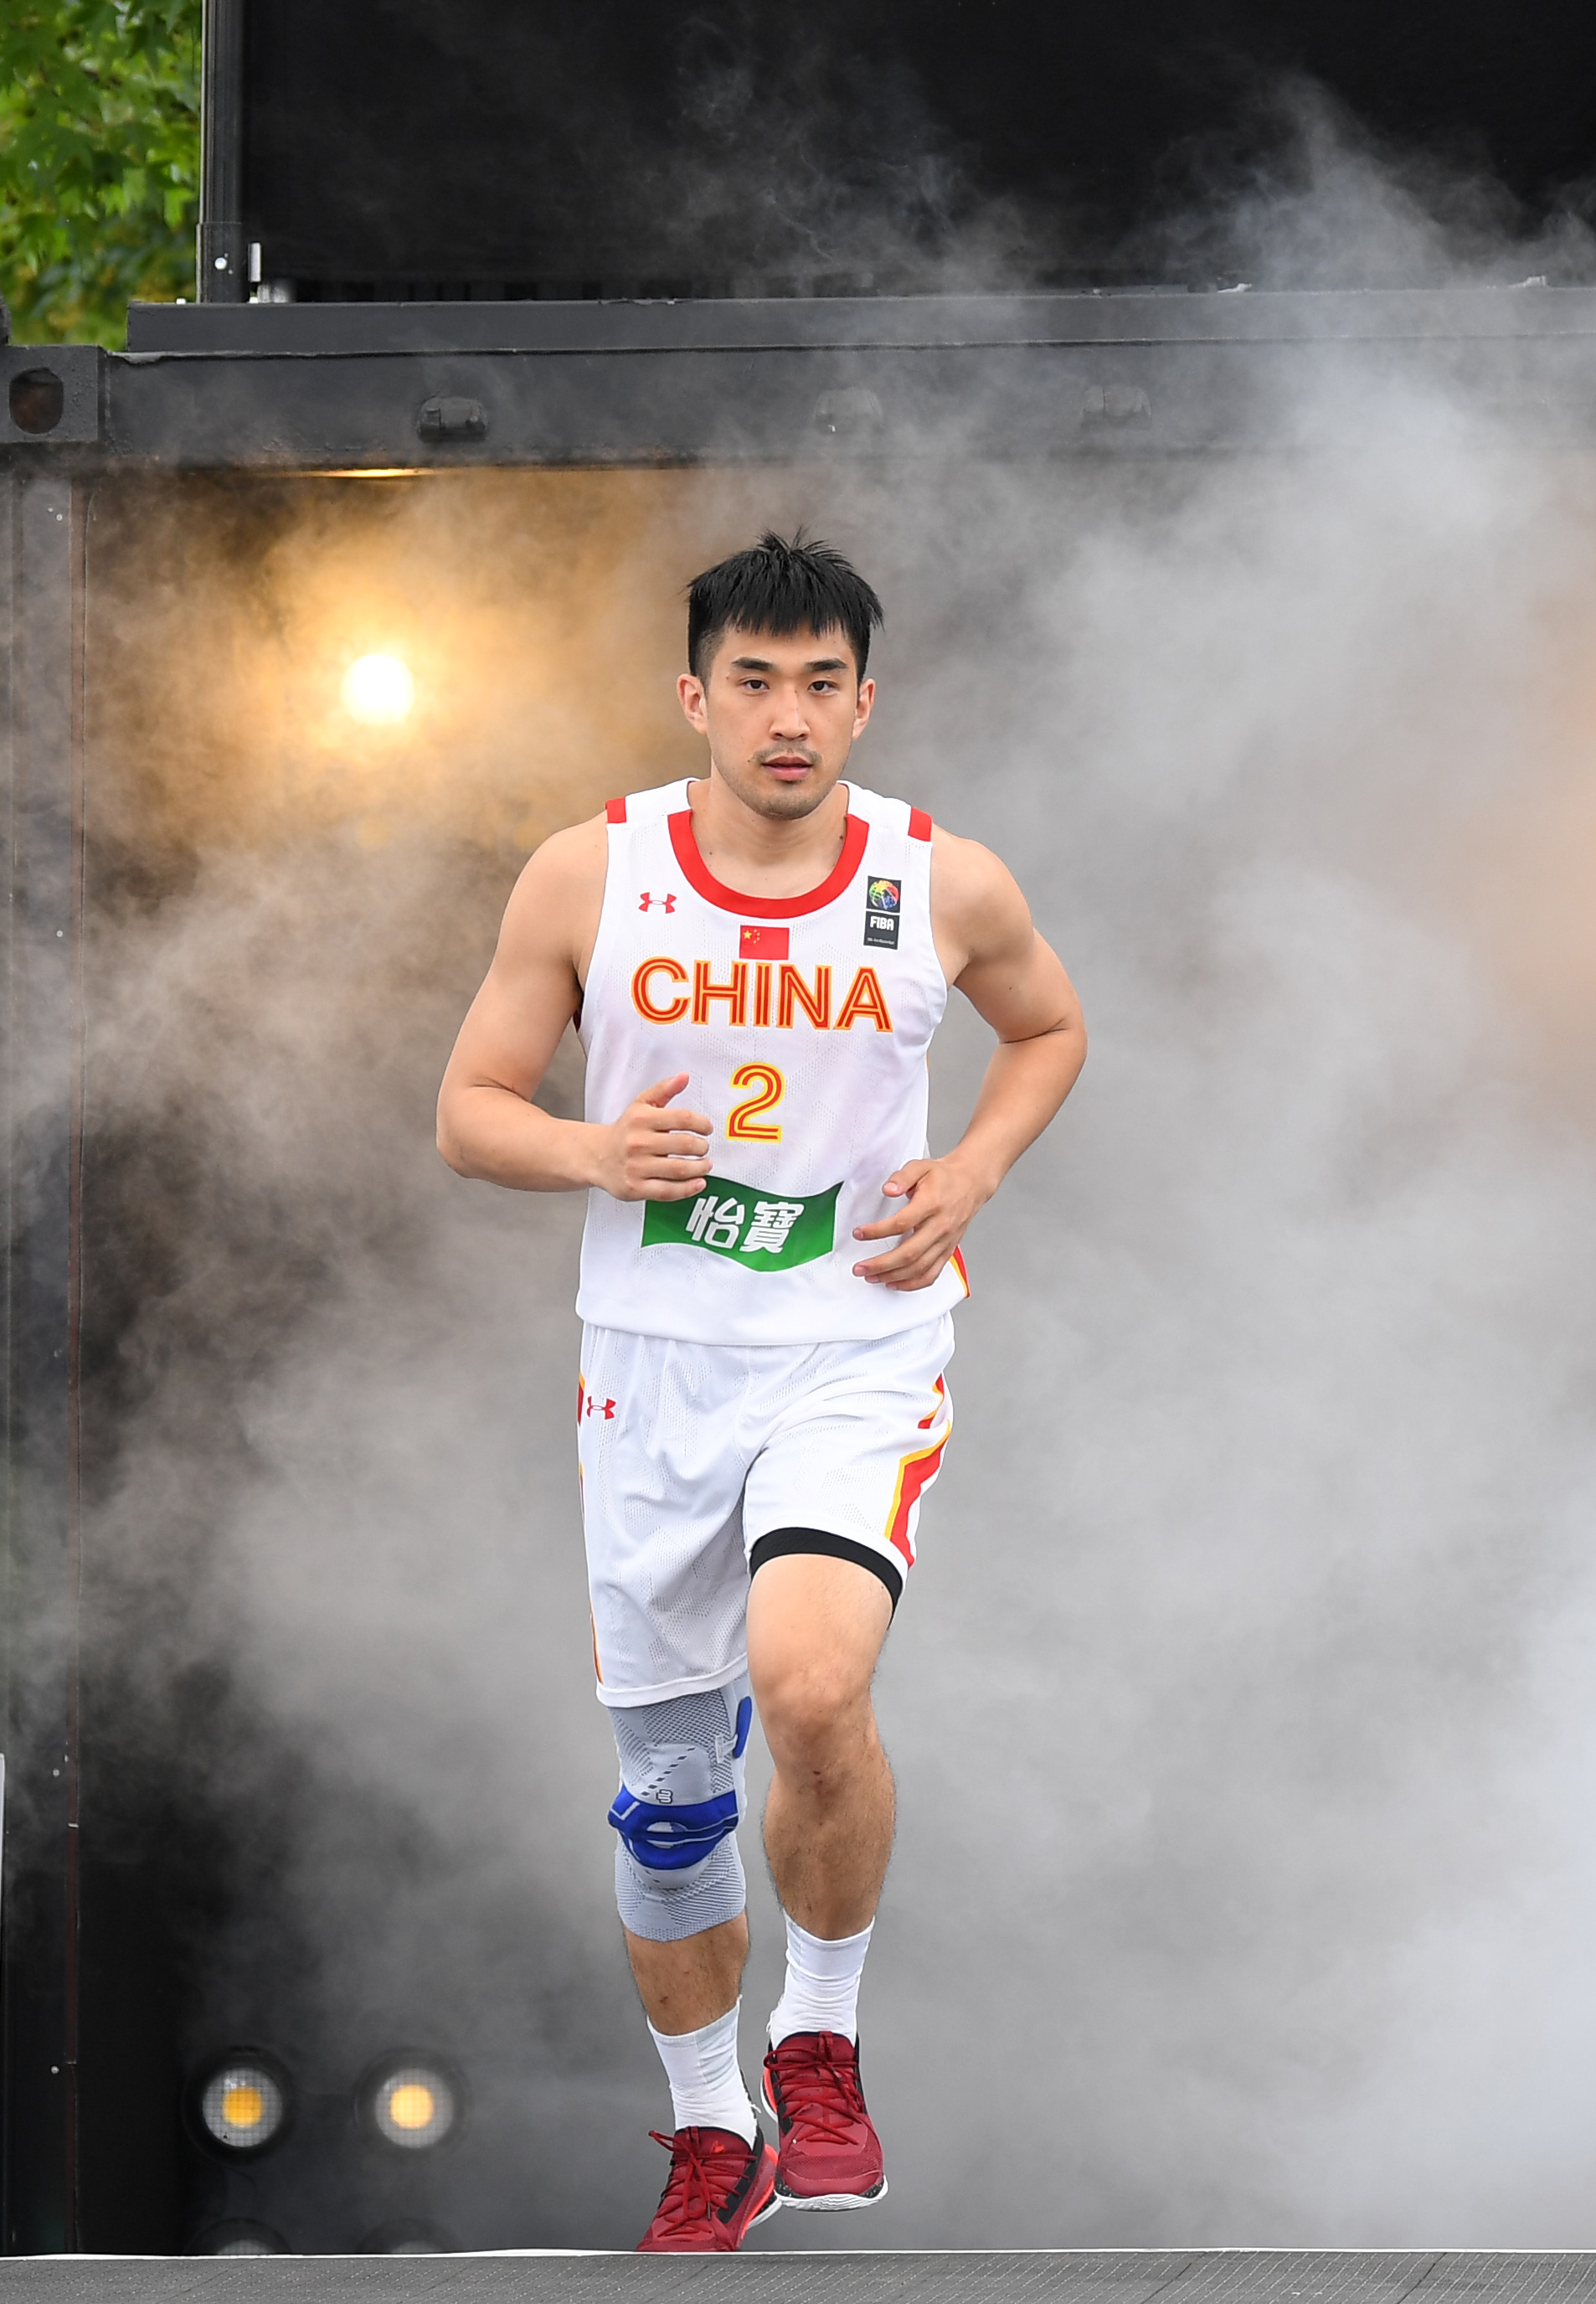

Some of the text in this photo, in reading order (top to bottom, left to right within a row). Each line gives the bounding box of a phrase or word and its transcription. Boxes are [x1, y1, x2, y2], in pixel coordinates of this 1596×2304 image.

[870, 915, 894, 931] FIBA
[632, 957, 893, 1032] CHINA
[727, 1062, 785, 1142] 2
[686, 1195, 804, 1253] 怡寶
